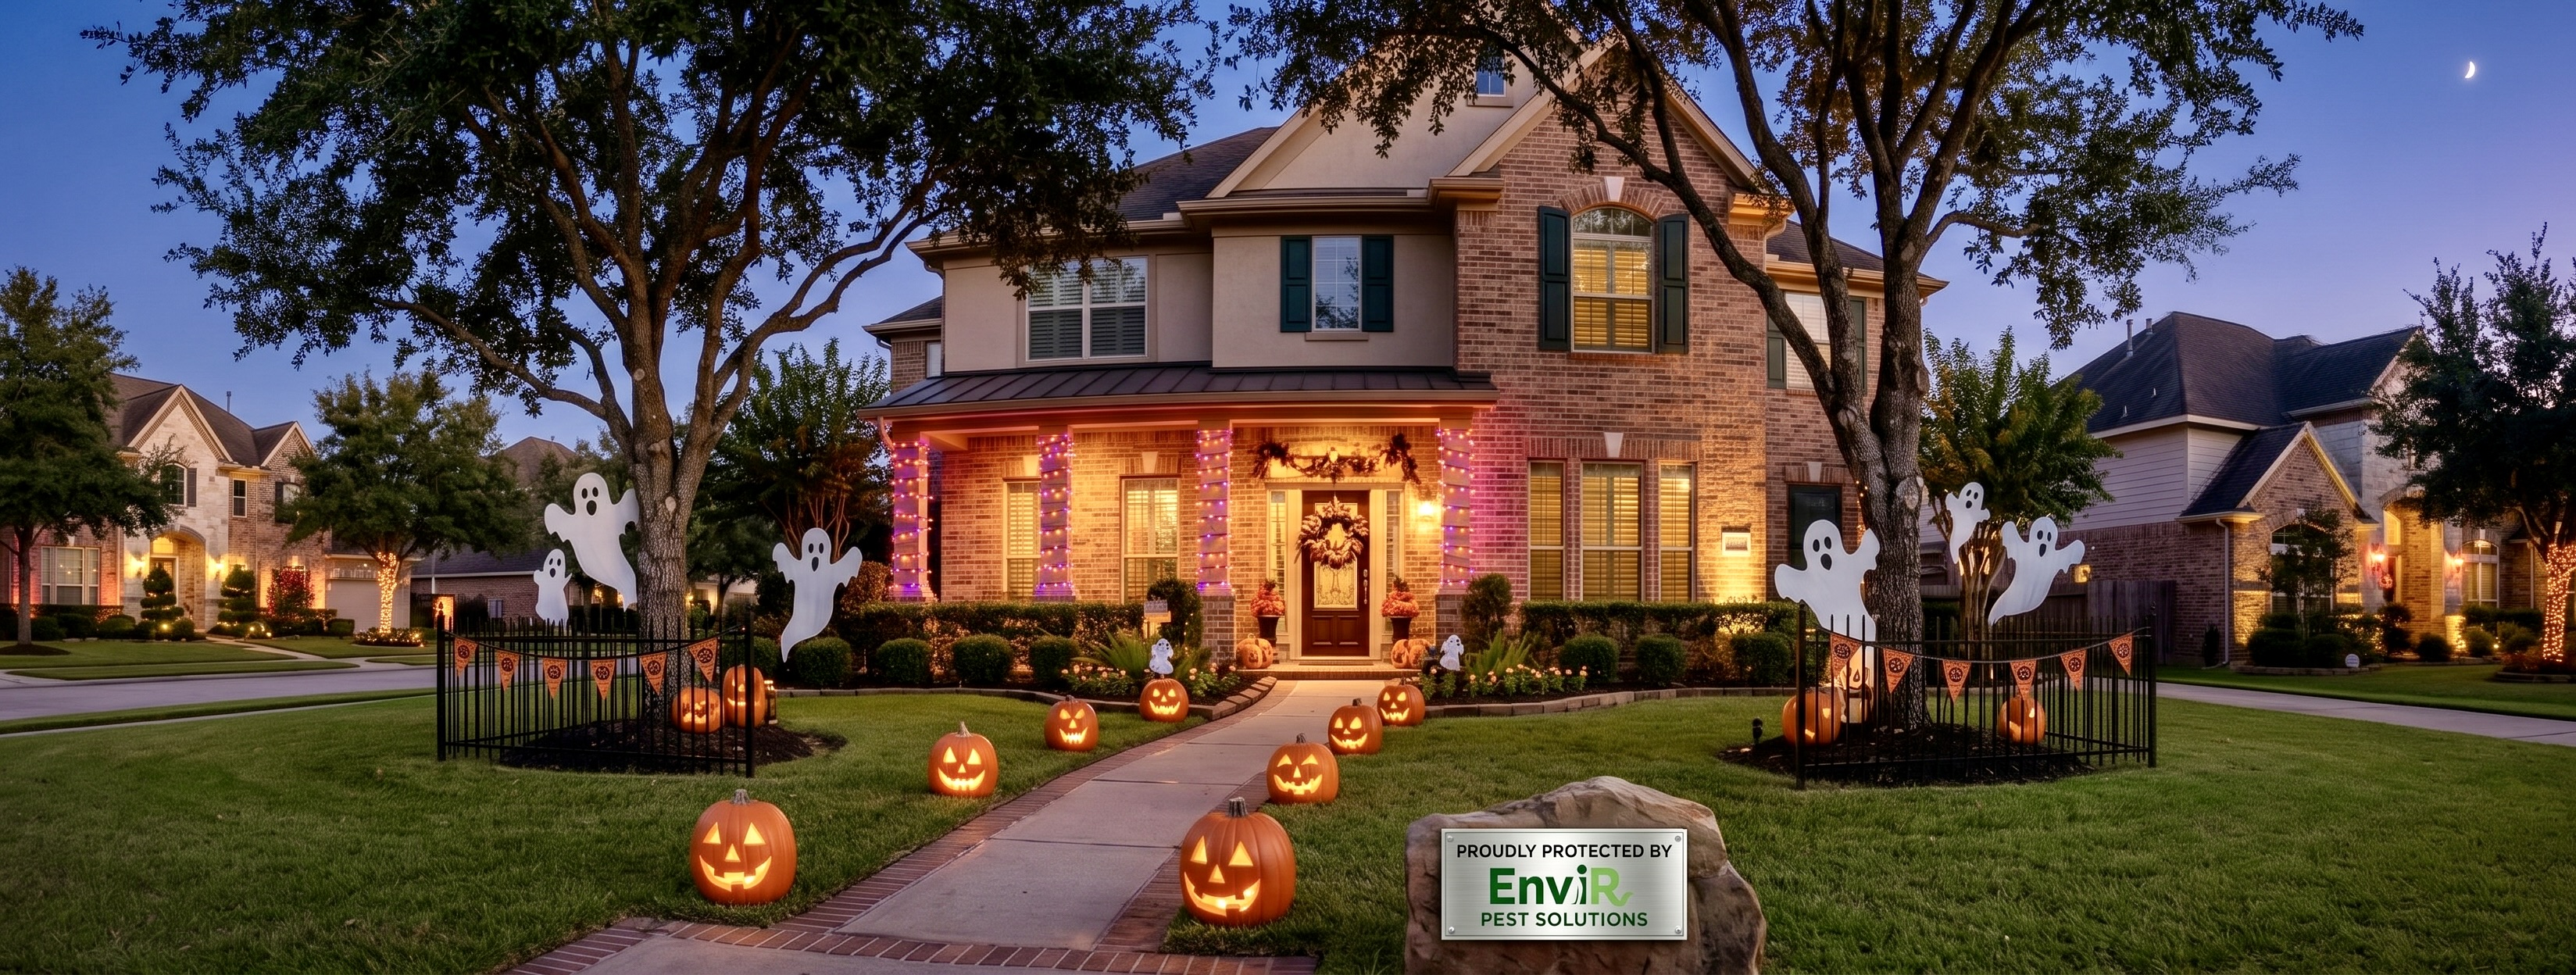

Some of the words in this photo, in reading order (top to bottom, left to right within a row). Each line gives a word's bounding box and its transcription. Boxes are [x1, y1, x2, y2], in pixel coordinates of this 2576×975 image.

[1456, 844, 1537, 858] PROUDLY
[1542, 844, 1645, 858] PROTECTED
[1649, 844, 1673, 858] BY
[1481, 912, 1529, 927] PEST
[1535, 912, 1649, 927] SOLUTIONS
